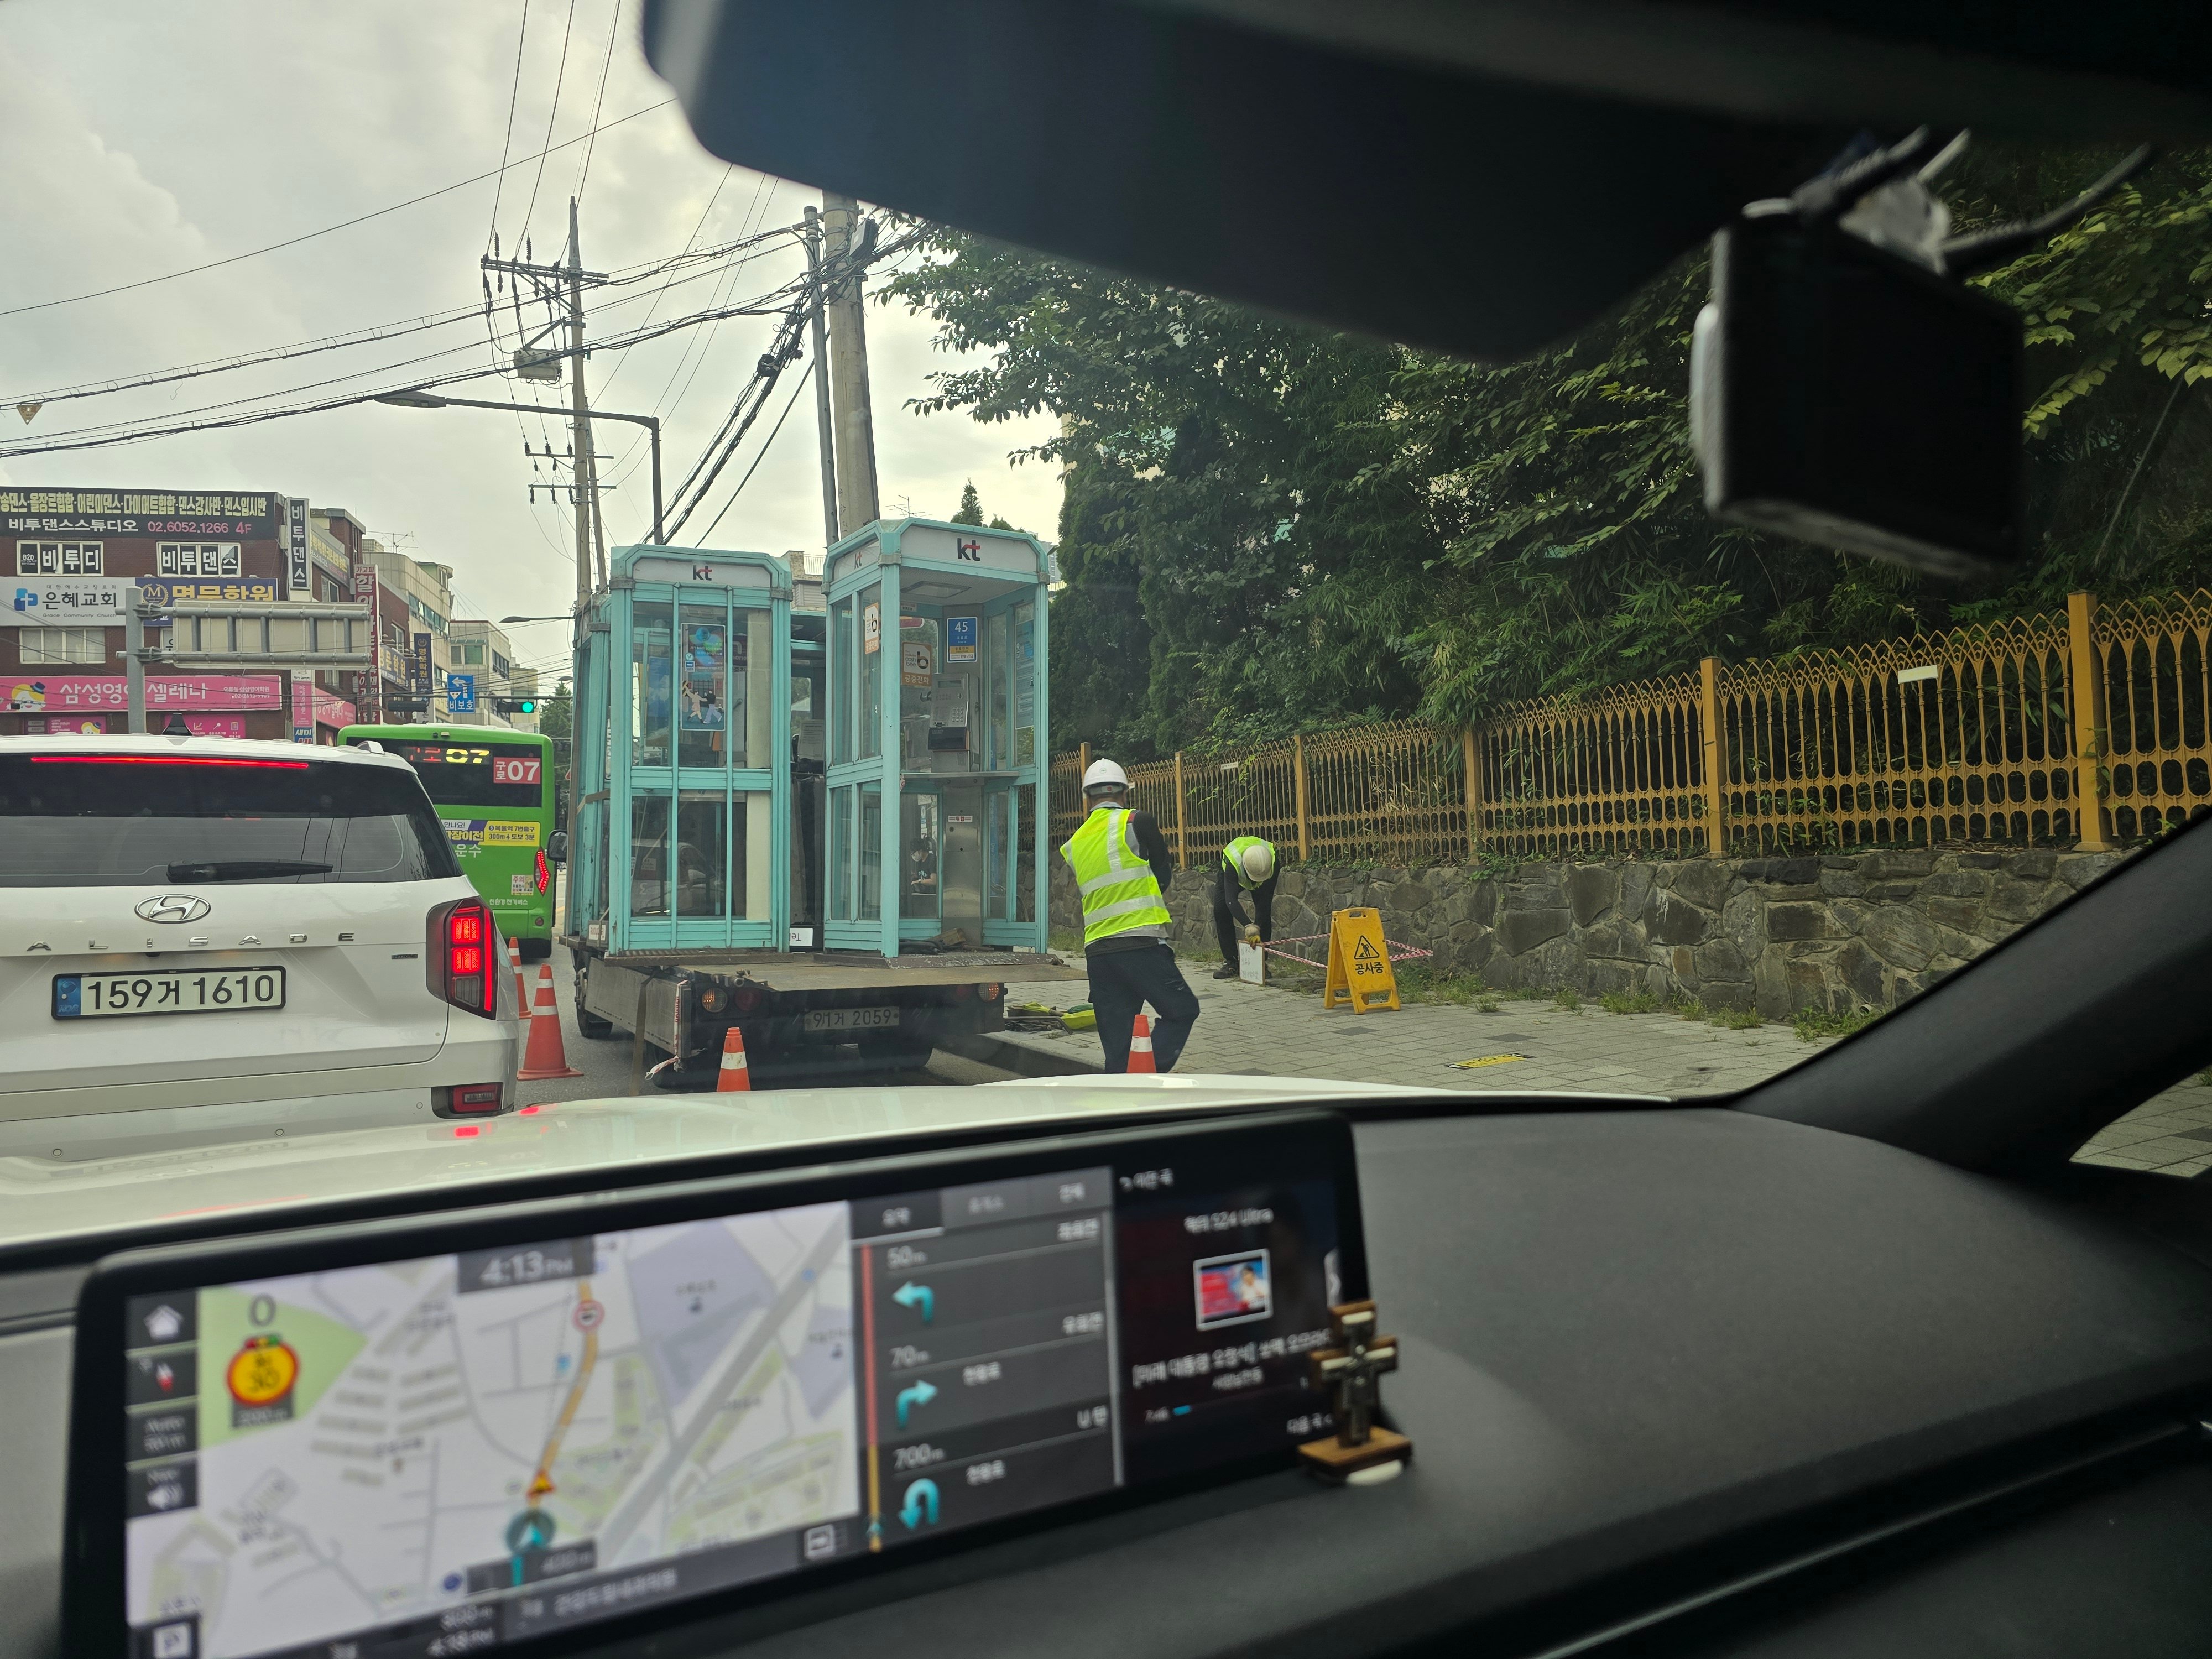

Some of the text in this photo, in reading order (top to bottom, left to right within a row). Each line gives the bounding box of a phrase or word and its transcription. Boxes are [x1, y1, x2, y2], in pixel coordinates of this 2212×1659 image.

[9, 518, 252, 534] 비투댄스스튜디오 02.6052.1266 4F
[291, 505, 305, 582] 비투댄스
[957, 538, 980, 561] kt
[163, 550, 237, 571] 비투댄스
[854, 551, 862, 570] kt
[693, 565, 712, 581] kt
[42, 592, 117, 610] 은혜교회
[954, 621, 968, 632] 45
[905, 675, 929, 684] 공중전화
[60, 683, 208, 704] 삼성영 셀레나
[450, 700, 474, 711] 비보호
[446, 748, 490, 764] 07
[495, 761, 540, 781] 구로 07
[455, 844, 482, 858] 운수
[1355, 962, 1384, 975] 공사중
[88, 974, 274, 1010] 159거 1610
[852, 1009, 891, 1026] 2059
